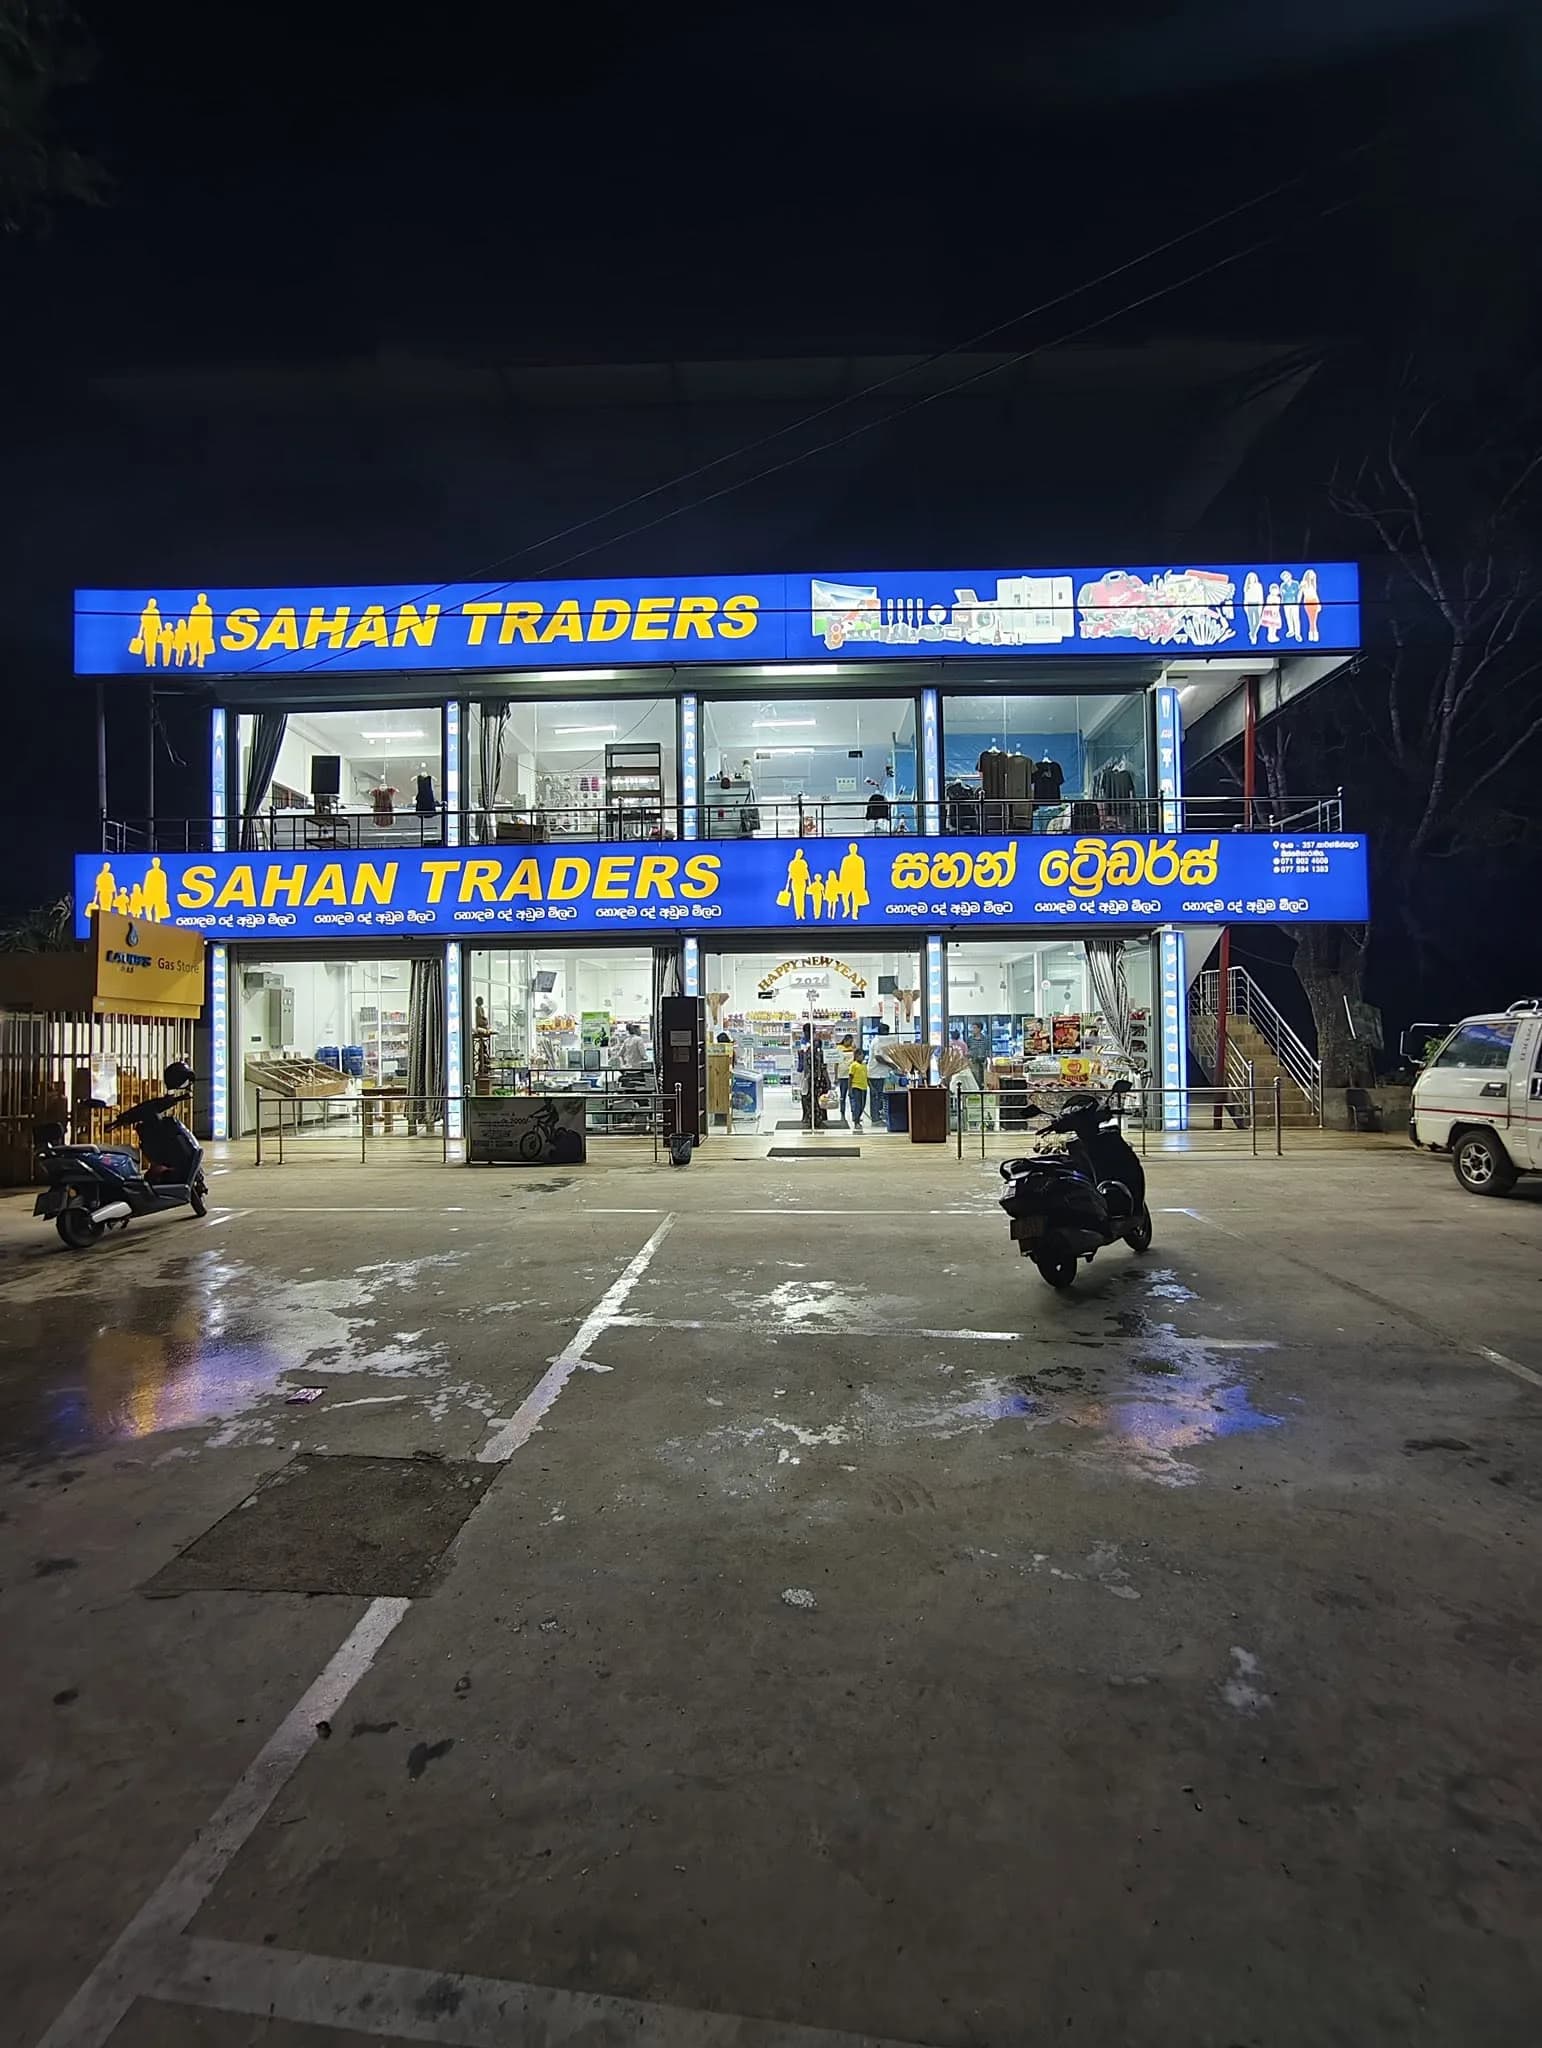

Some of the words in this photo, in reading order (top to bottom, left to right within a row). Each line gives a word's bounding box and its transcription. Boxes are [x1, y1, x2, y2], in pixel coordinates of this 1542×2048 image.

[221, 604, 439, 651] SAHAN
[462, 595, 759, 645] TRADERS
[891, 841, 1018, 889] සහන්
[177, 862, 398, 908] SAHAN
[422, 855, 721, 903] TRADERS
[640, 905, 657, 919] දේ
[930, 902, 948, 916] දේ
[1079, 900, 1096, 914] දේ
[1227, 899, 1243, 913] දේ
[218, 914, 234, 927] දේ
[357, 911, 373, 925] දේ
[497, 908, 513, 922] දේ
[158, 957, 175, 971] Gas
[176, 959, 200, 974] Store
[757, 959, 799, 991] HAPPY
[801, 955, 834, 968] NEW
[835, 960, 868, 991] YEAR
